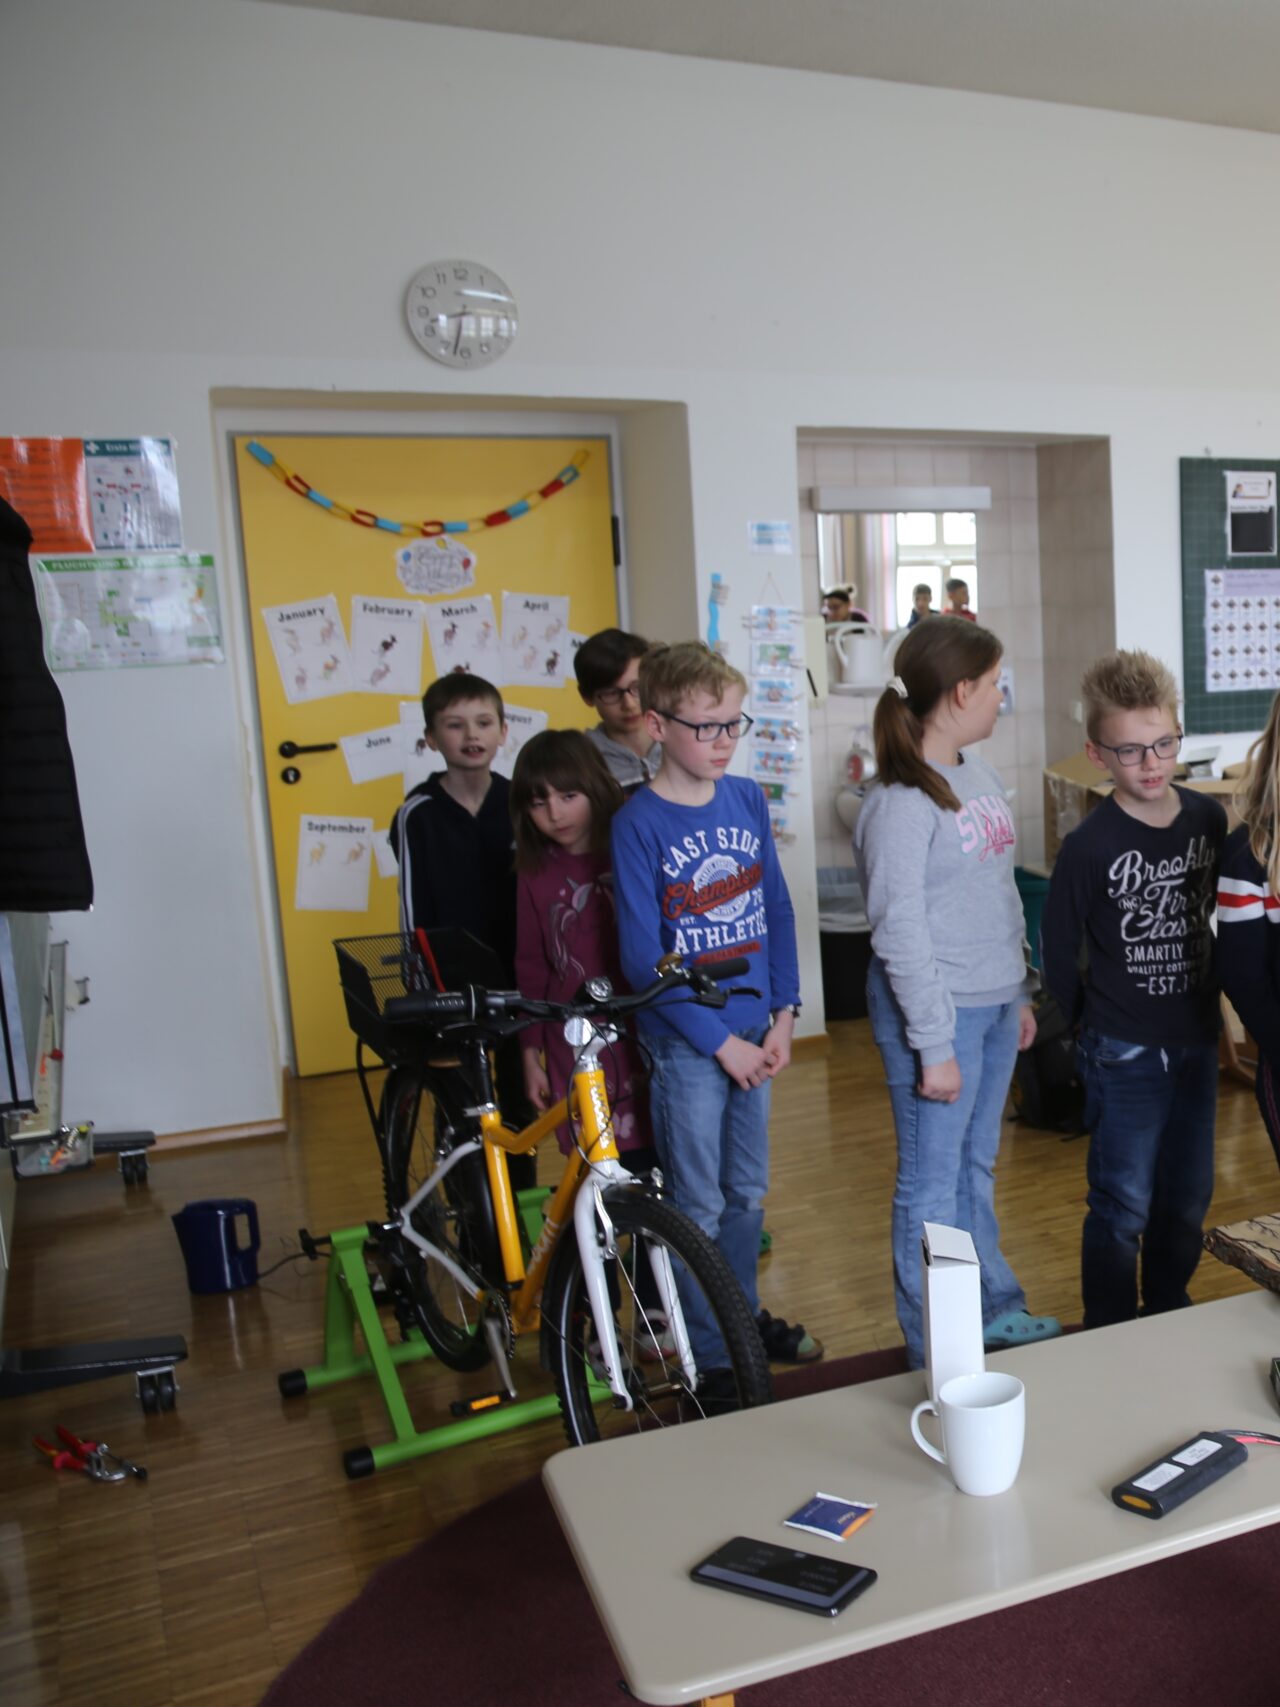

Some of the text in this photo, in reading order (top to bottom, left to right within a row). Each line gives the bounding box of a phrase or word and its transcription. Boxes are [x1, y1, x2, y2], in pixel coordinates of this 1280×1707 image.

[453, 268, 469, 281] 12
[419, 286, 437, 298] 10
[362, 603, 413, 619] February
[441, 604, 477, 618] March
[523, 600, 549, 613] April
[278, 607, 325, 624] January
[503, 713, 533, 727] ugust
[365, 736, 392, 749] June
[306, 822, 367, 835] September
[662, 827, 760, 878] EAST SIDE
[673, 908, 767, 955] ATHLETIC
[1125, 943, 1184, 963] SMARTLY
